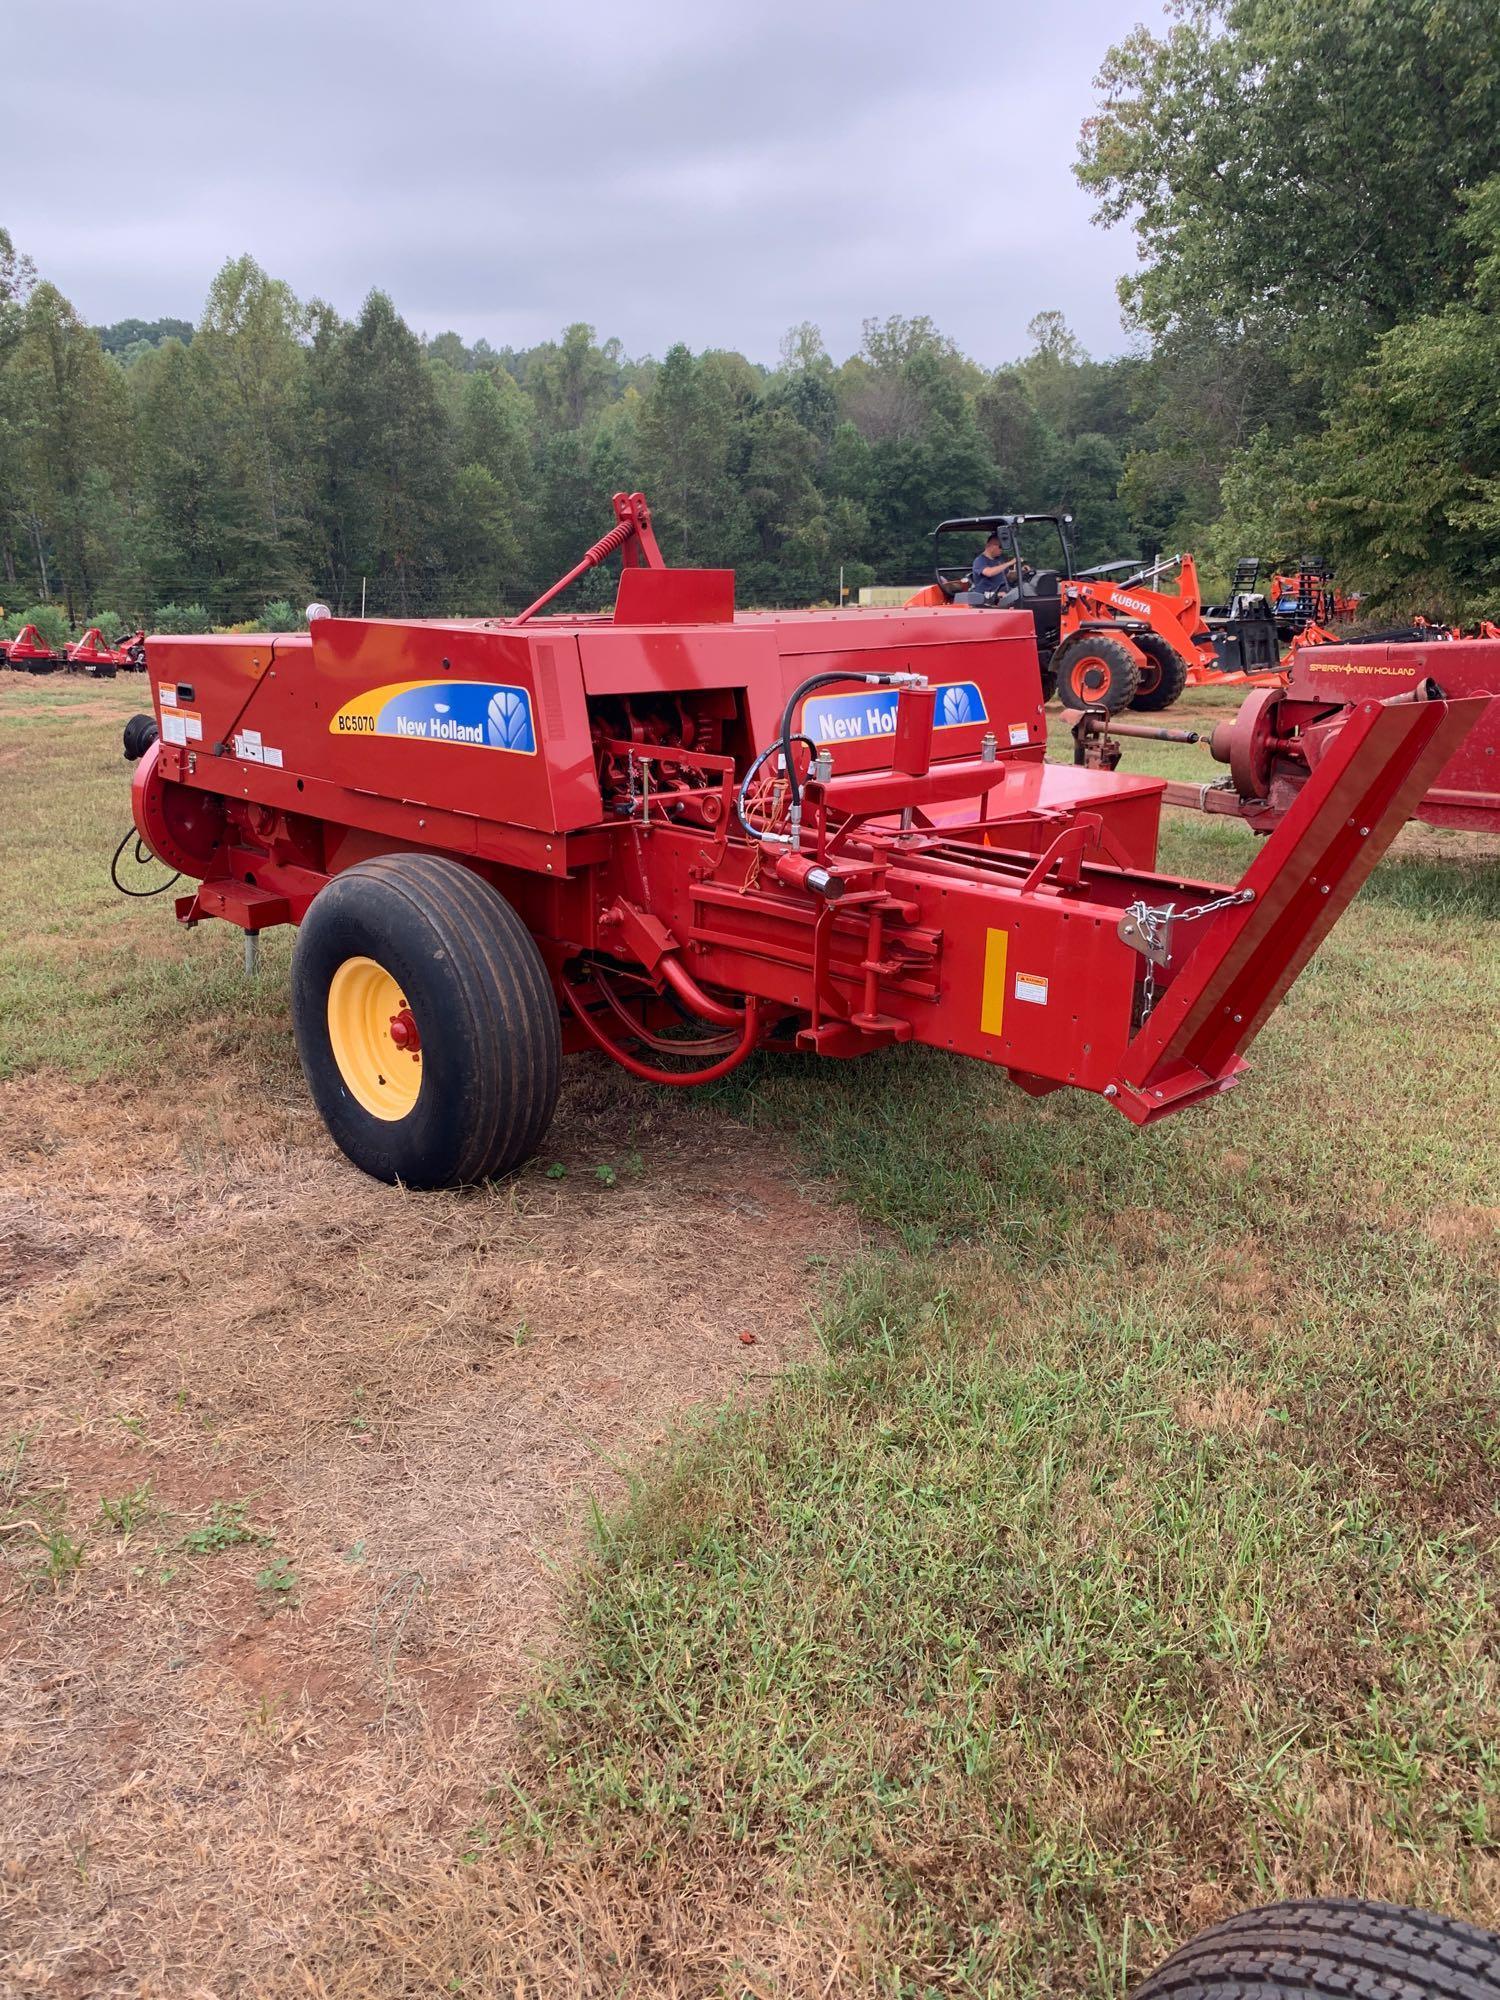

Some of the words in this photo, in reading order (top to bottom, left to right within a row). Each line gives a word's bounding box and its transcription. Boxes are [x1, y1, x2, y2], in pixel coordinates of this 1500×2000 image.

[1111, 593, 1151, 614] KUBOTA
[1309, 663, 1343, 673] SPERRY
[1353, 665, 1374, 674] NEW
[1374, 666, 1415, 676] HOLLAND
[338, 716, 375, 731] BC5070
[397, 716, 426, 735] New
[430, 718, 482, 742] Holland
[819, 714, 862, 739] New
[867, 706, 898, 733] Hol
